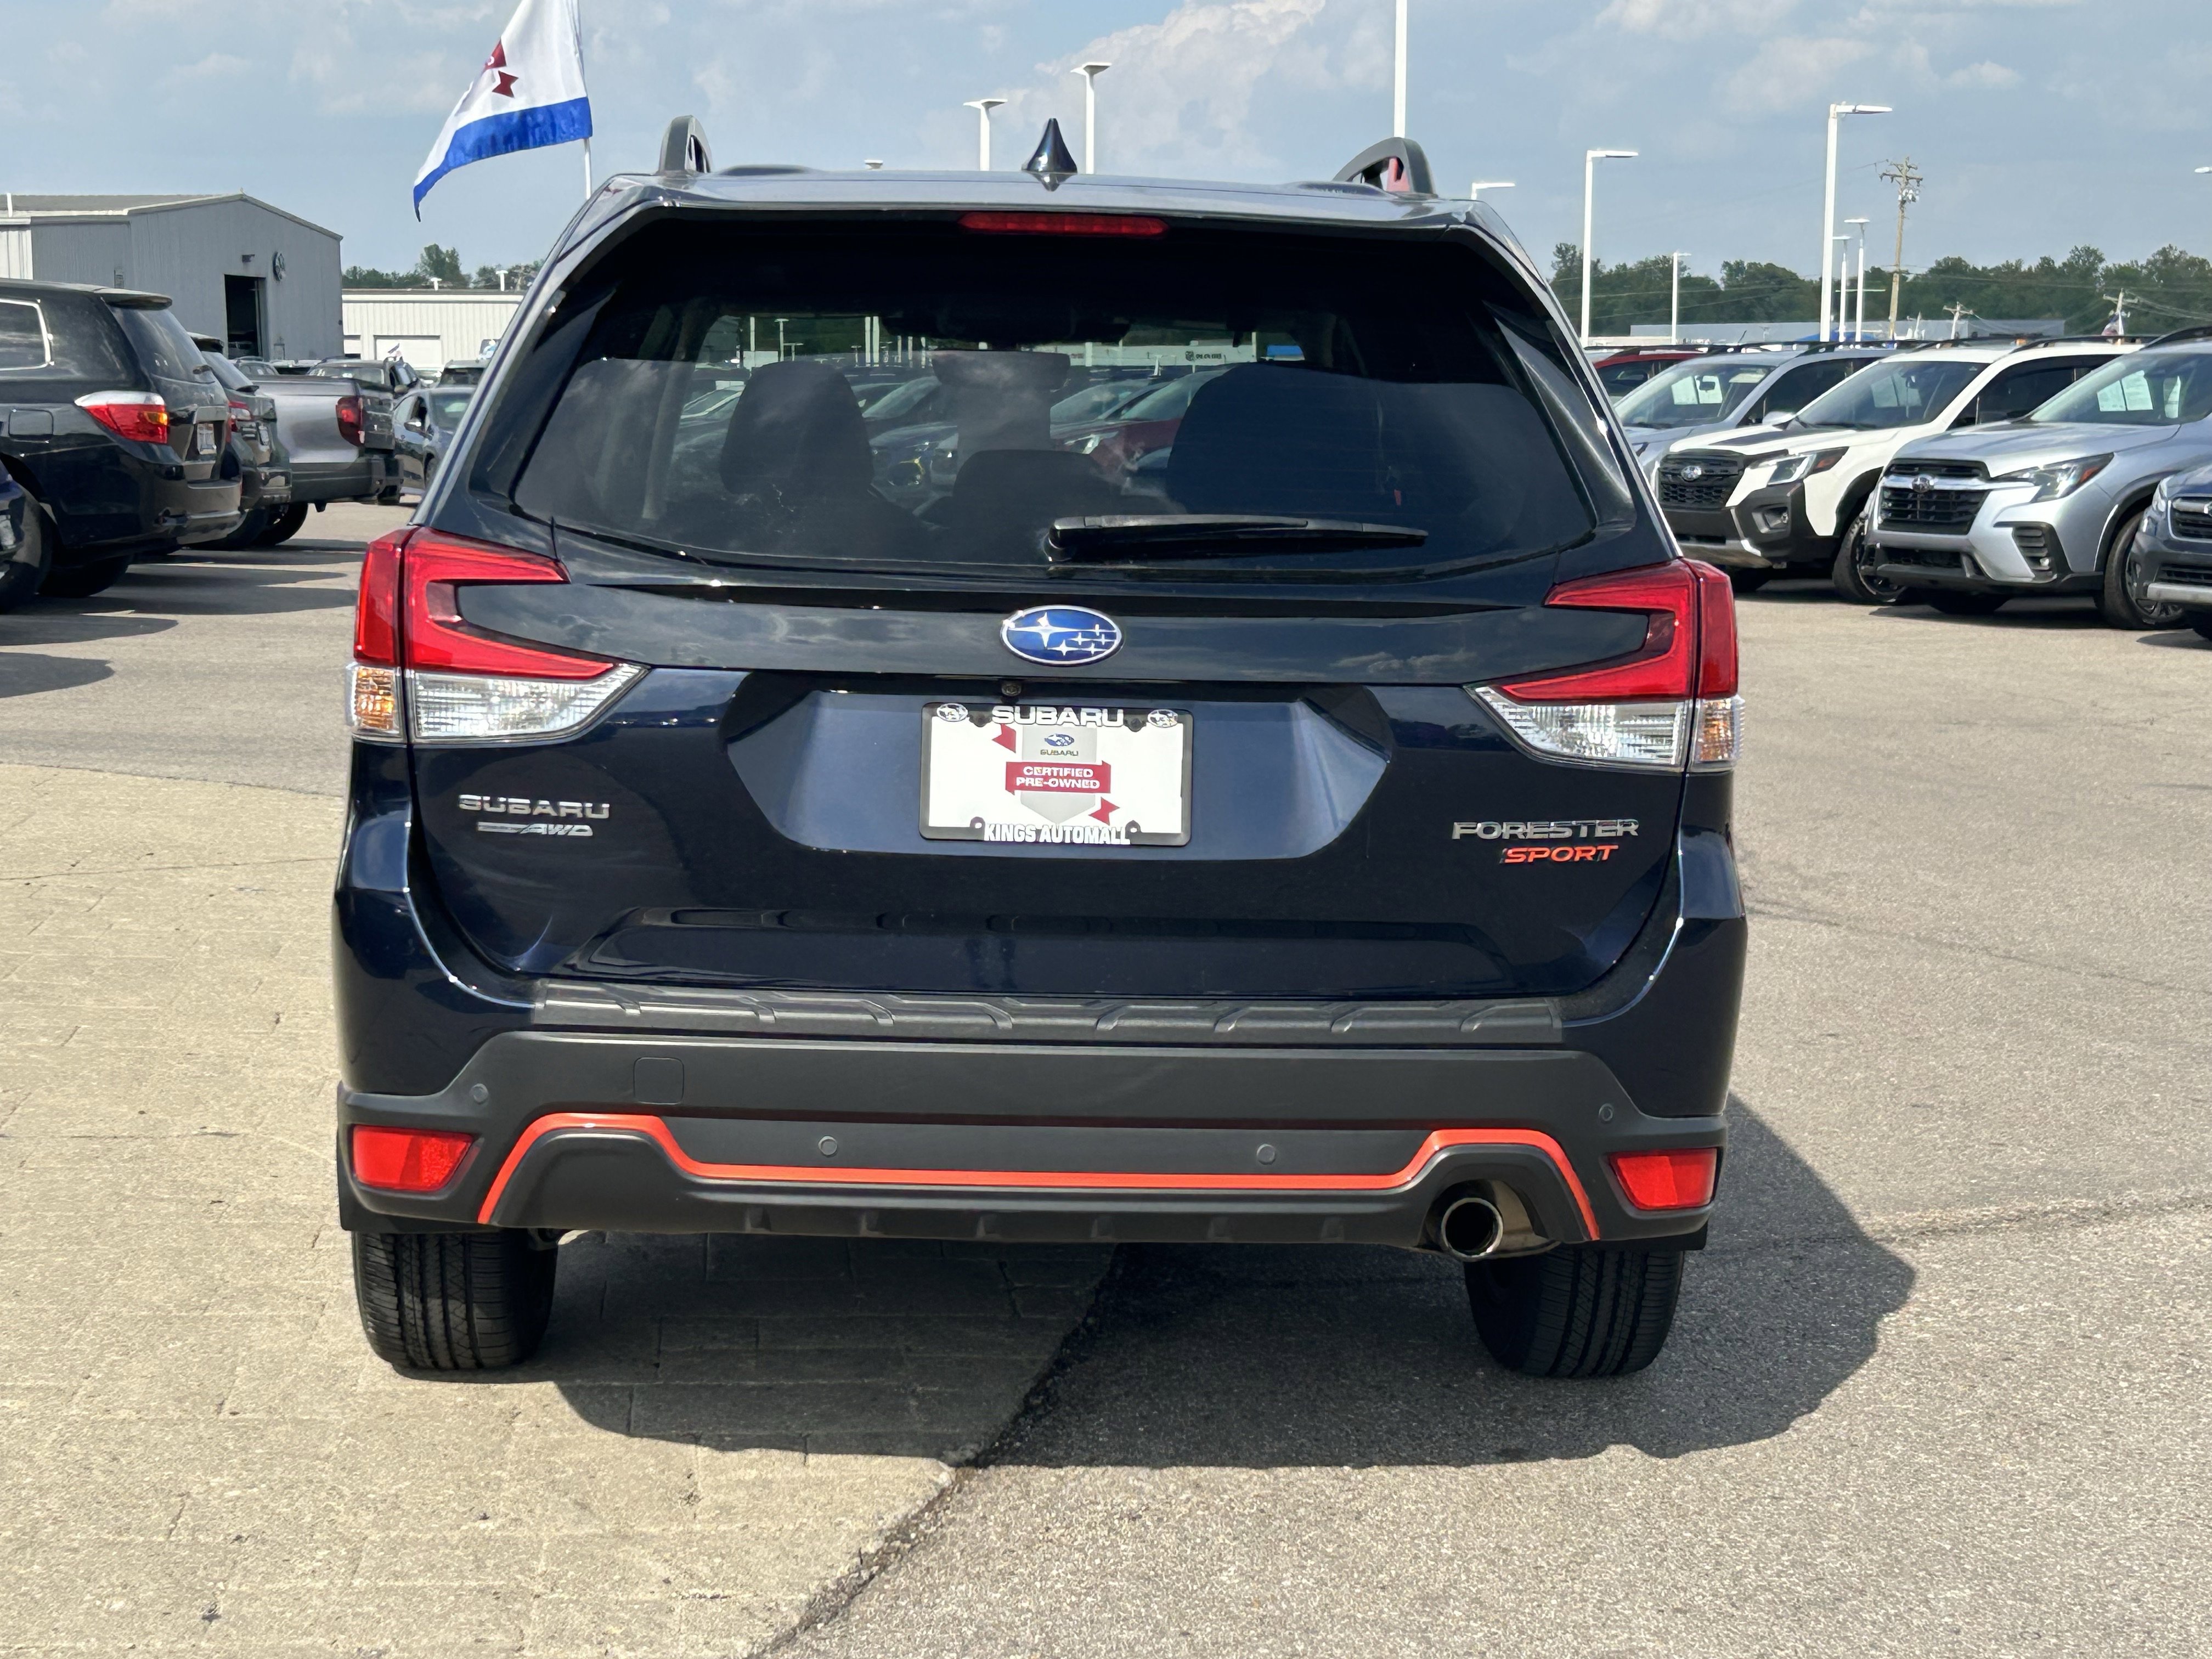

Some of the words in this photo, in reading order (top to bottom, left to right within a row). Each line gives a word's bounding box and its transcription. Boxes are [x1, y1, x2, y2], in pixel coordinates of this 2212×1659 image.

[991, 706, 1124, 727] SUBARU
[1023, 766, 1094, 778] CERTIFIED
[1015, 777, 1101, 789] PRE-OWNED
[459, 794, 610, 819] SUBARU
[519, 823, 594, 837] AWD
[984, 823, 1036, 844] KINGS
[1040, 825, 1131, 845] AUTOMALL
[1452, 819, 1640, 840] FORESTER
[1501, 844, 1619, 864] SPORT
